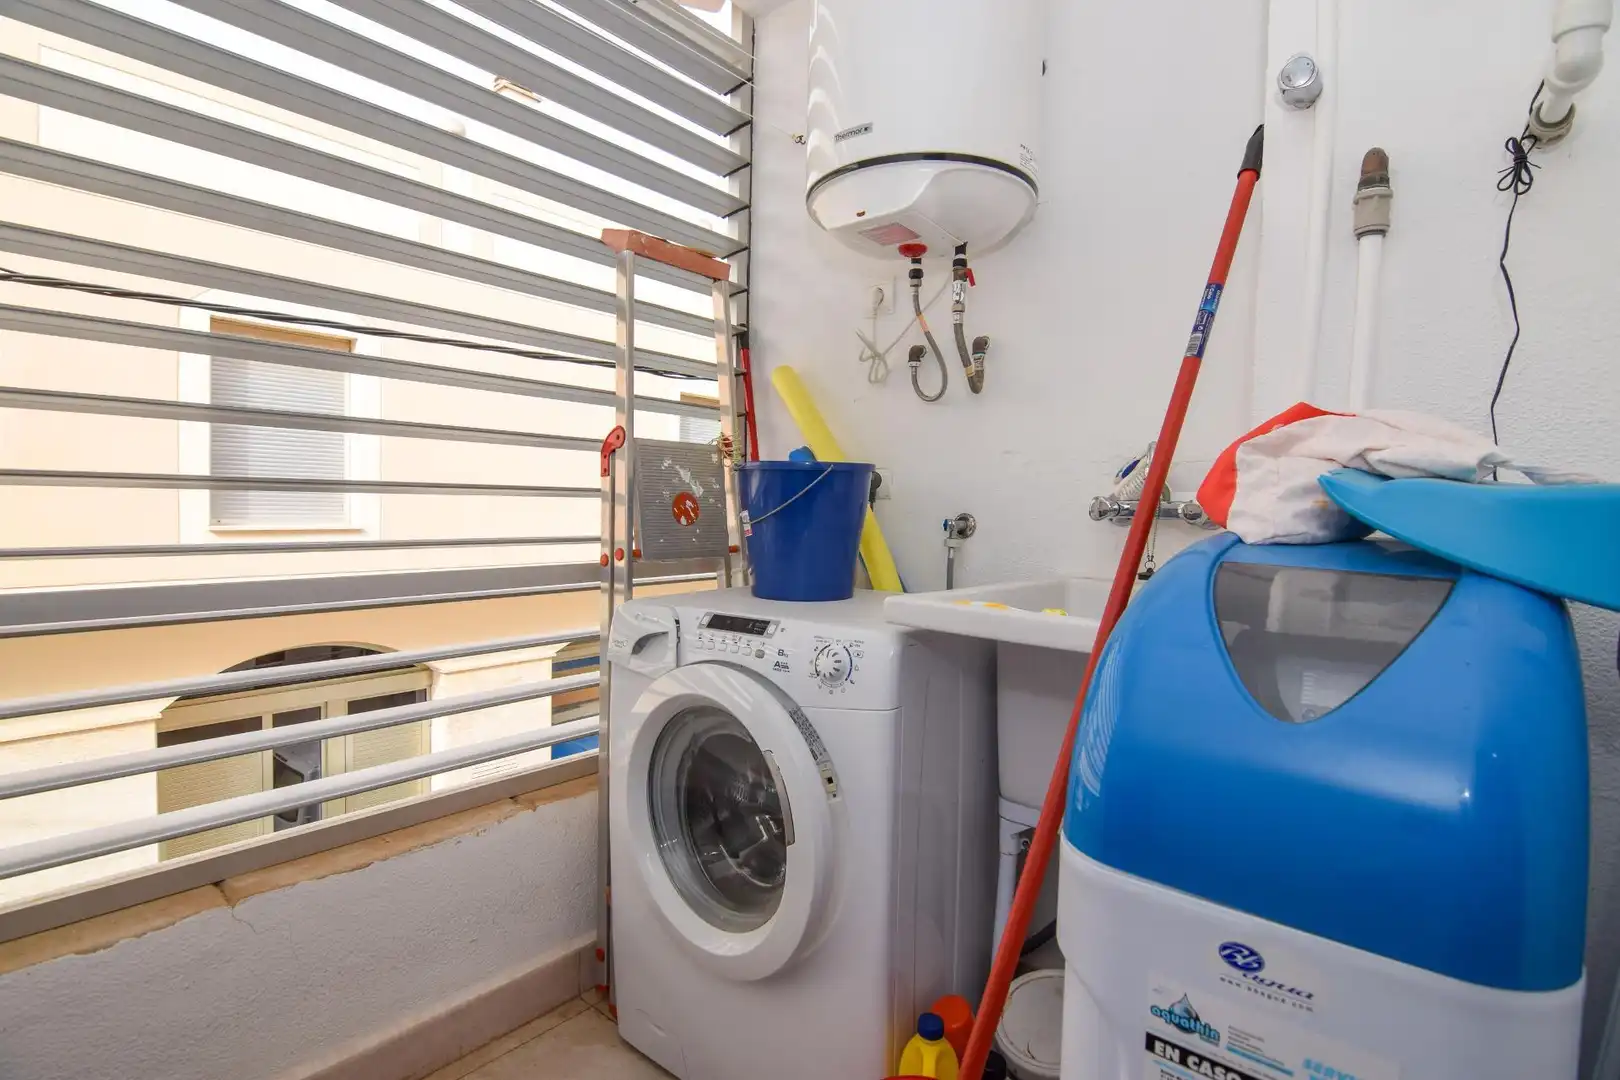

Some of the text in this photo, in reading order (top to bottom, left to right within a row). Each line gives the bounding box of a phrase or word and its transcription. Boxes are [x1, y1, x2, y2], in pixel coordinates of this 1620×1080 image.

[834, 126, 863, 141] Thermor
[1150, 1005, 1220, 1042] aquathin
[1153, 1039, 1180, 1063] EN
